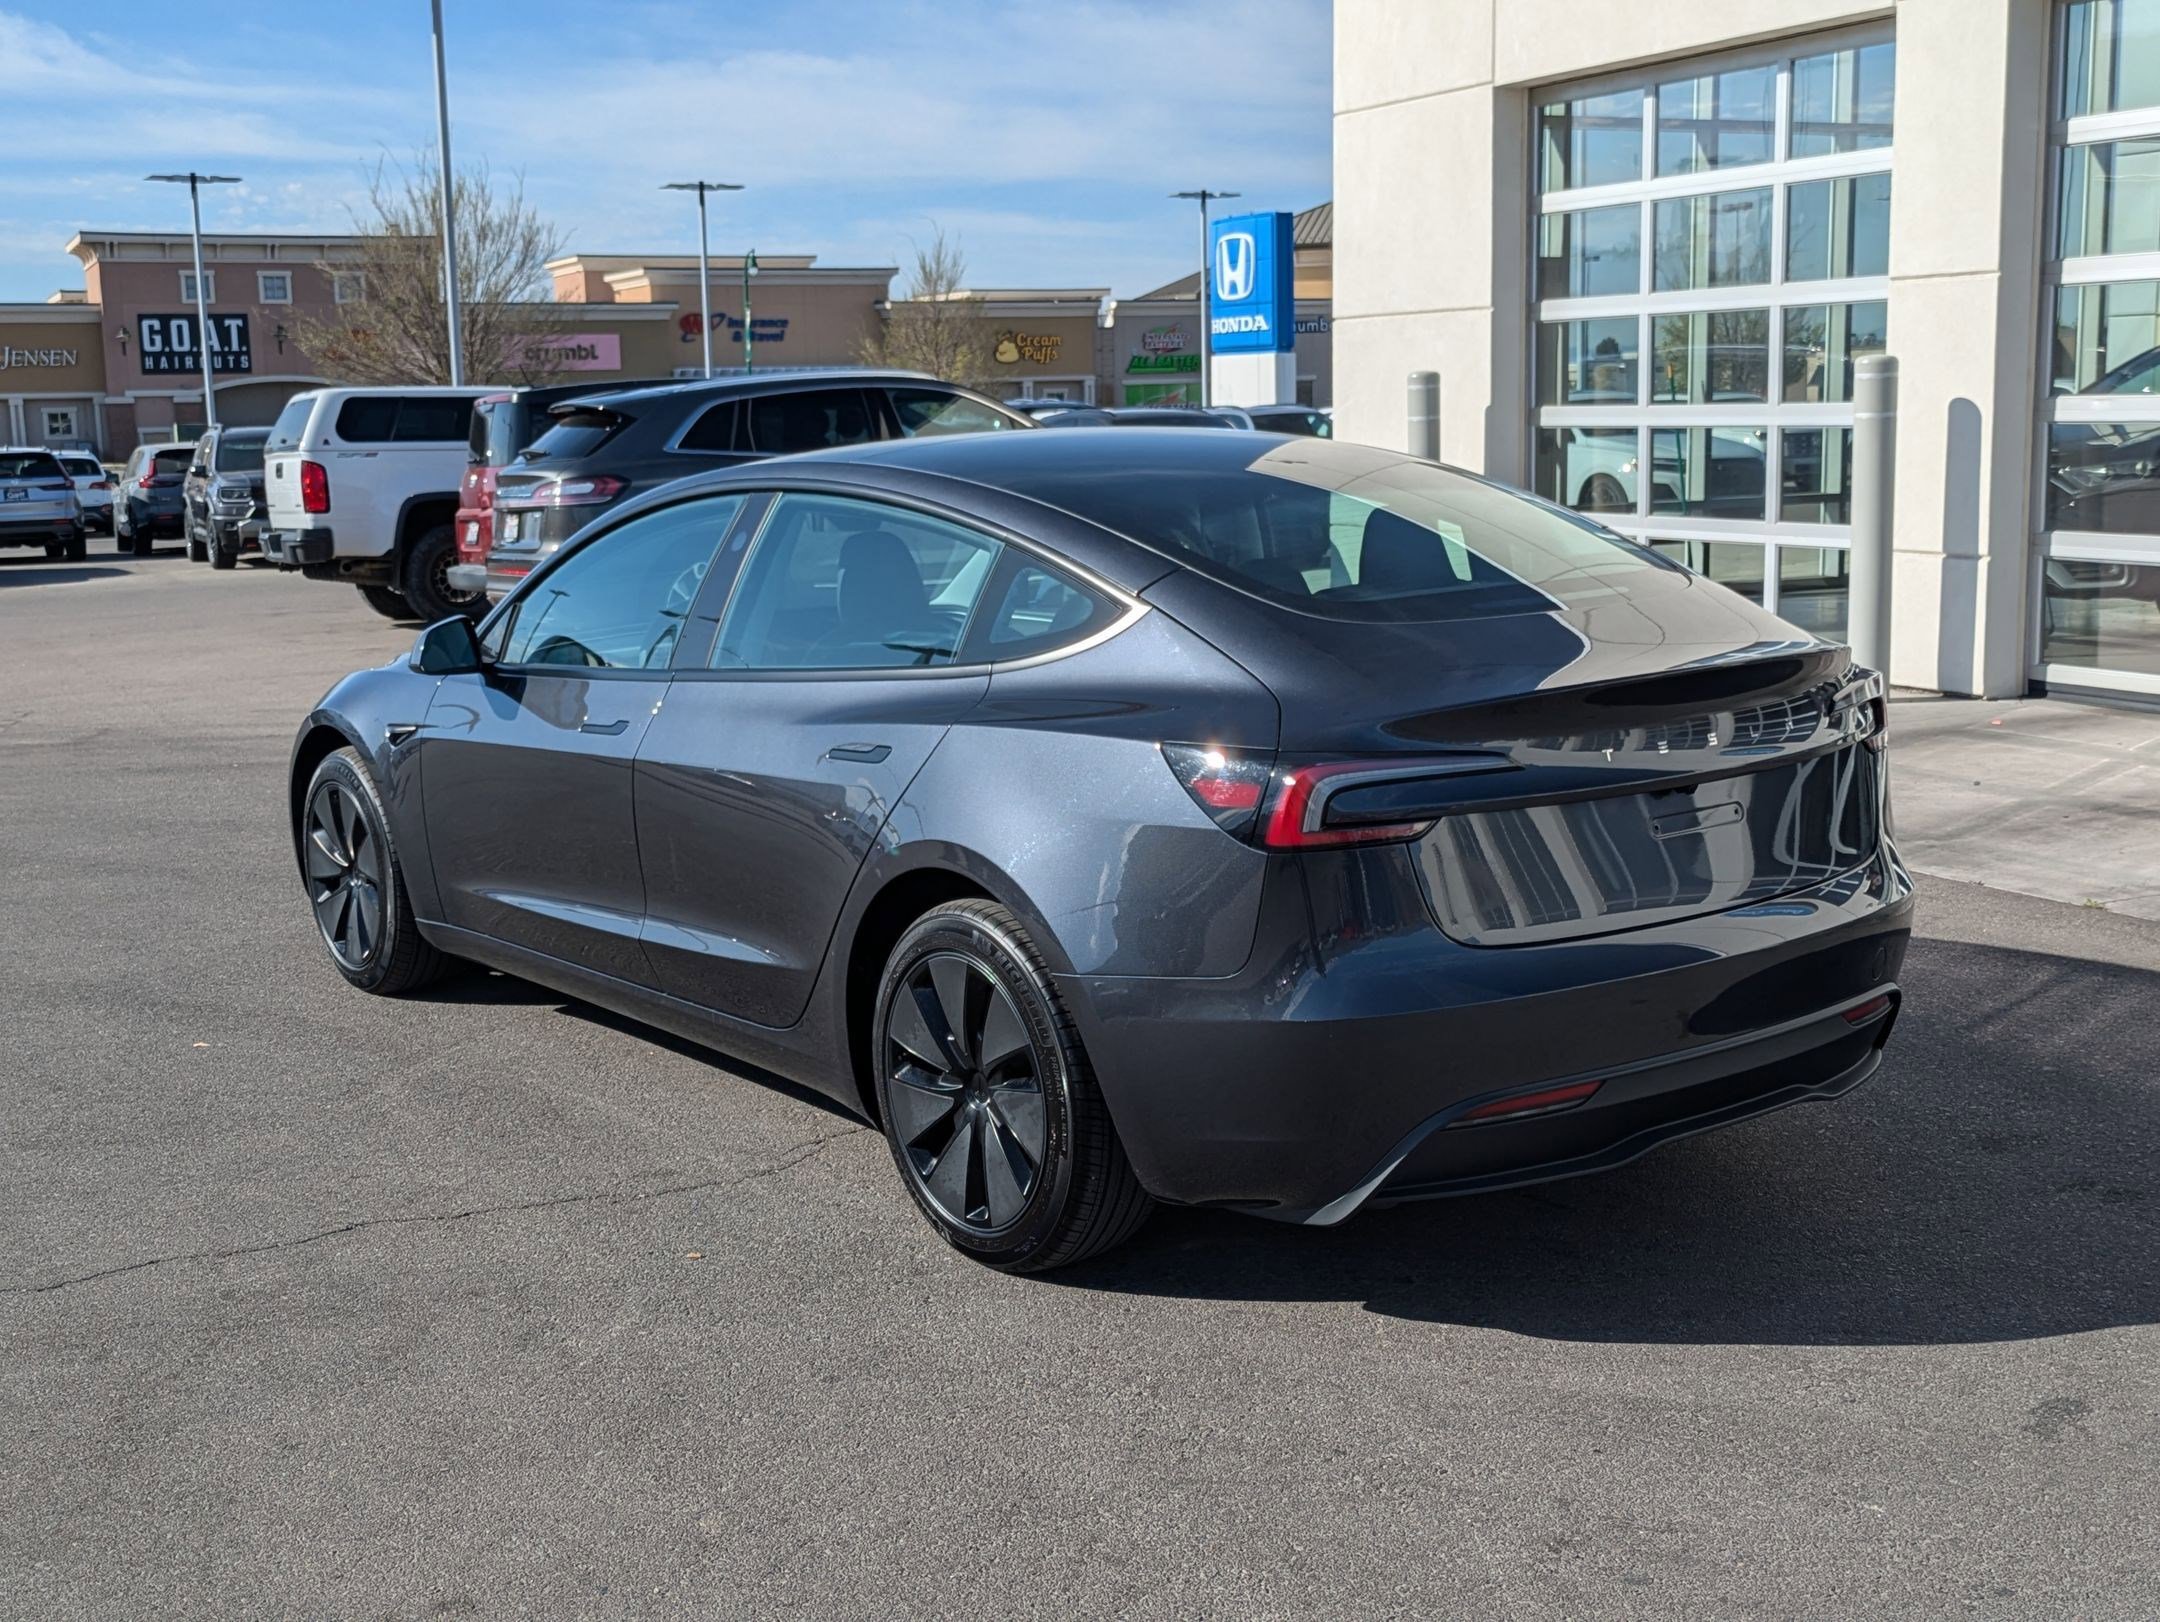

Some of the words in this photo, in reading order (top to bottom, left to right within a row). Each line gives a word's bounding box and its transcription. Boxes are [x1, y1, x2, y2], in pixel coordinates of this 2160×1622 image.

[1210, 315, 1269, 334] HONDA
[1291, 316, 1328, 333] umb
[1016, 333, 1062, 346] Cream
[0, 346, 77, 370] JENSEN
[145, 355, 249, 369] HAIRUTS
[1022, 347, 1058, 363] Puffs
[1154, 354, 1201, 368] BATTER
[1601, 719, 1794, 762] TESLA
